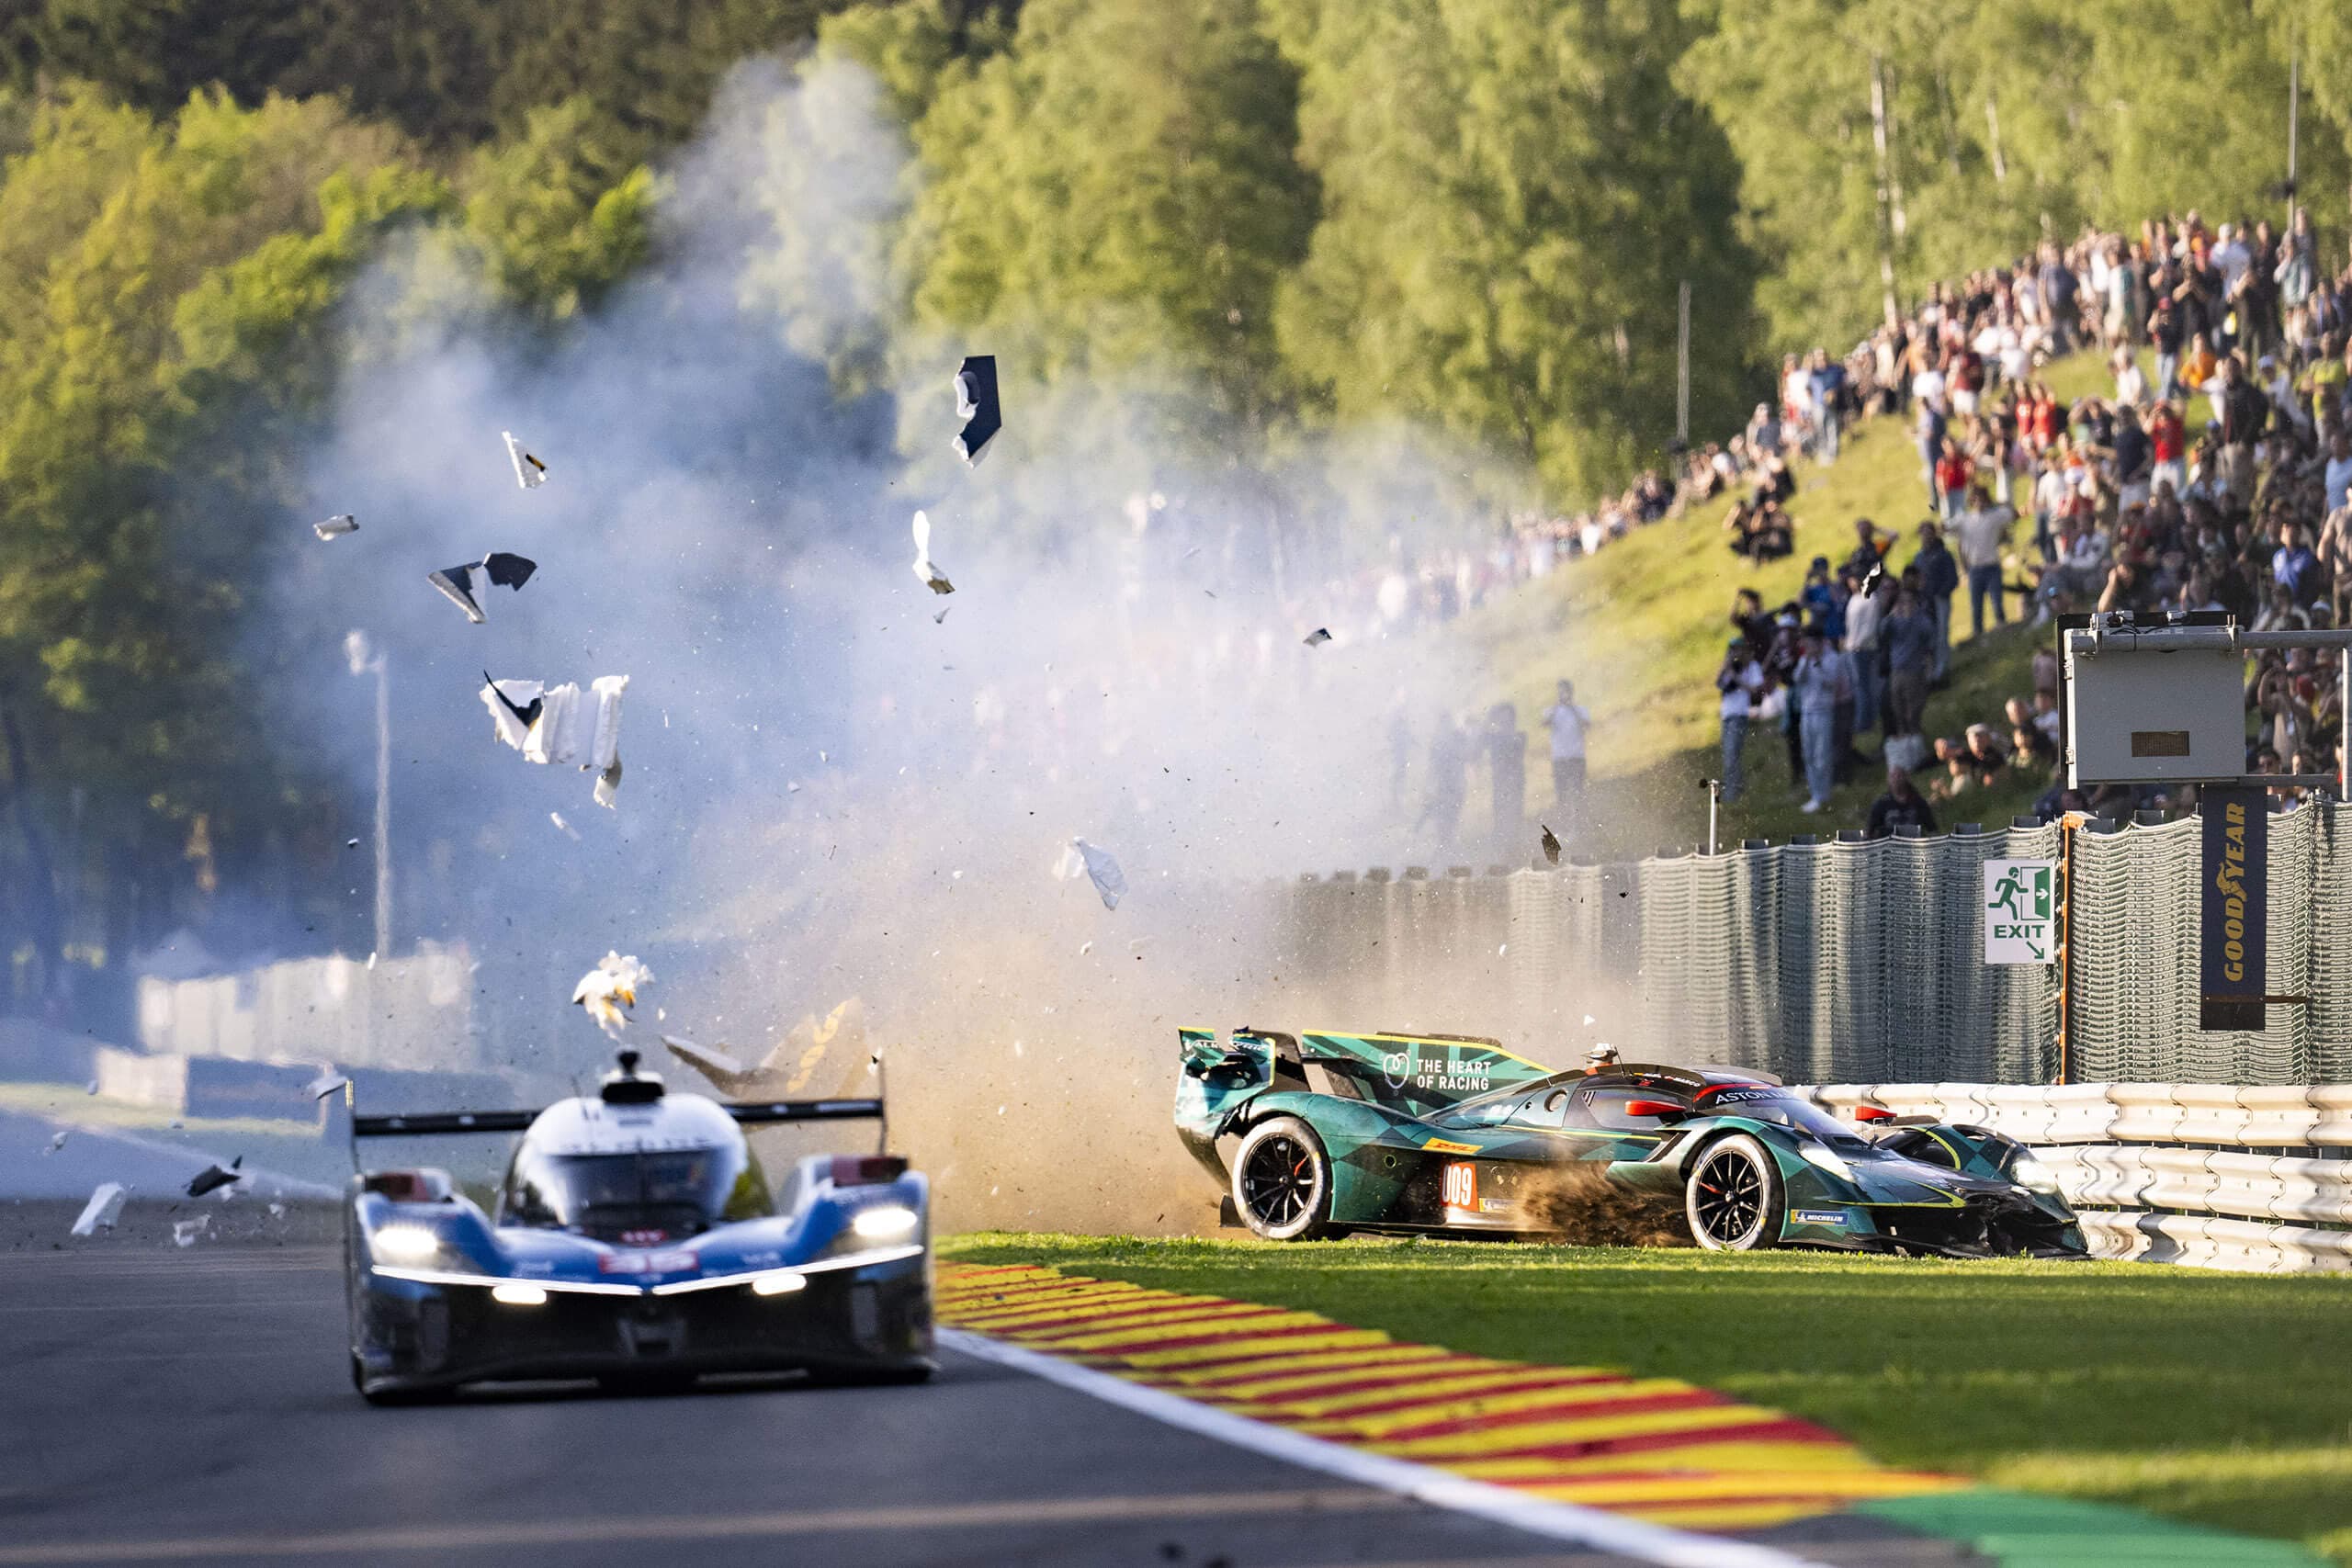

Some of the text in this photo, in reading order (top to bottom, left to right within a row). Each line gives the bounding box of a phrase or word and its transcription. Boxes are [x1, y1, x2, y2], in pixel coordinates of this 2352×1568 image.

[2223, 802, 2246, 982] GOODYEAR
[1994, 925, 2045, 938] EXIT
[1417, 1059, 1491, 1075] THE HEART
[1417, 1075, 1489, 1091] OF RACING
[1715, 1091, 1770, 1104] ASTON
[1442, 1164, 1473, 1206] 009
[1807, 1214, 1844, 1223] MICHELIN
